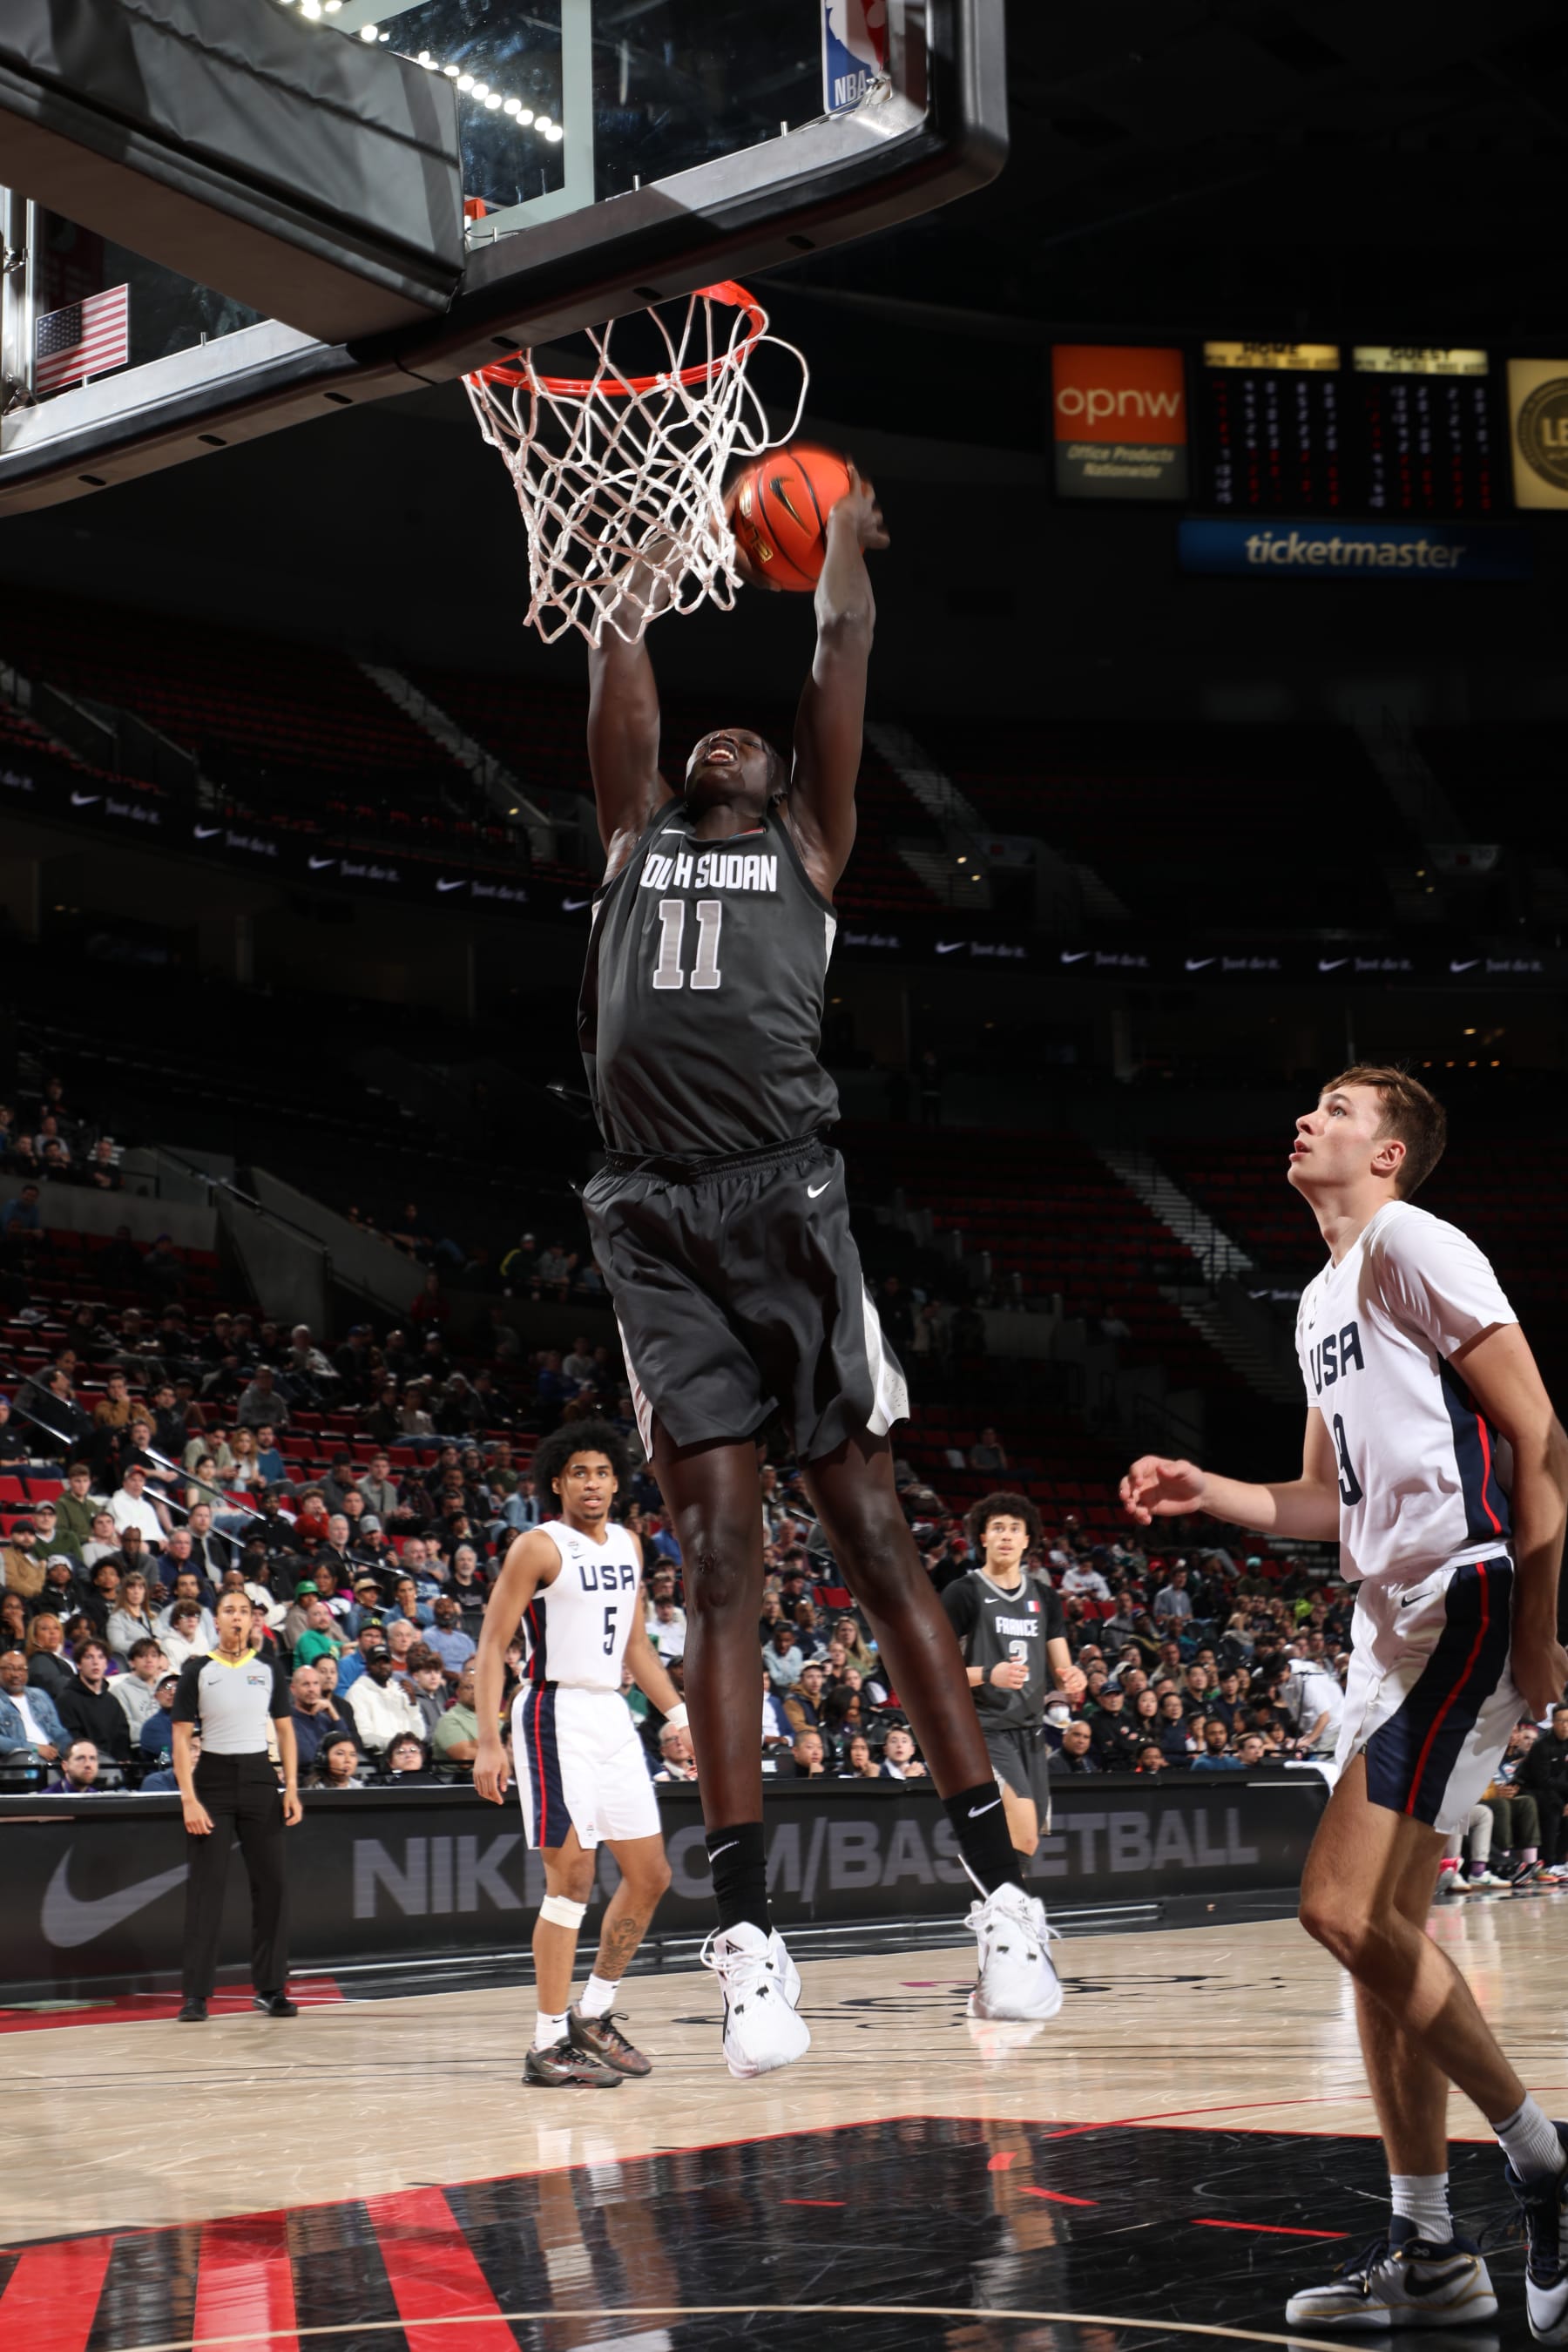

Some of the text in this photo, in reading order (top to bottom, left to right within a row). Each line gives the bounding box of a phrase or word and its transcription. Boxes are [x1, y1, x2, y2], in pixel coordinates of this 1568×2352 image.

[834, 70, 867, 106] NBA
[1057, 387, 1181, 425] opnw
[1066, 443, 1176, 463] Office Products
[1082, 461, 1164, 479] Nationwide
[1244, 531, 1469, 570] ticketmaster
[694, 853, 778, 892] SUDAN
[652, 899, 722, 989] 11
[1309, 1321, 1365, 1395] USA
[578, 1565, 636, 1592] USA
[602, 1606, 618, 1656] 5
[995, 1616, 1039, 1637] FRANCE
